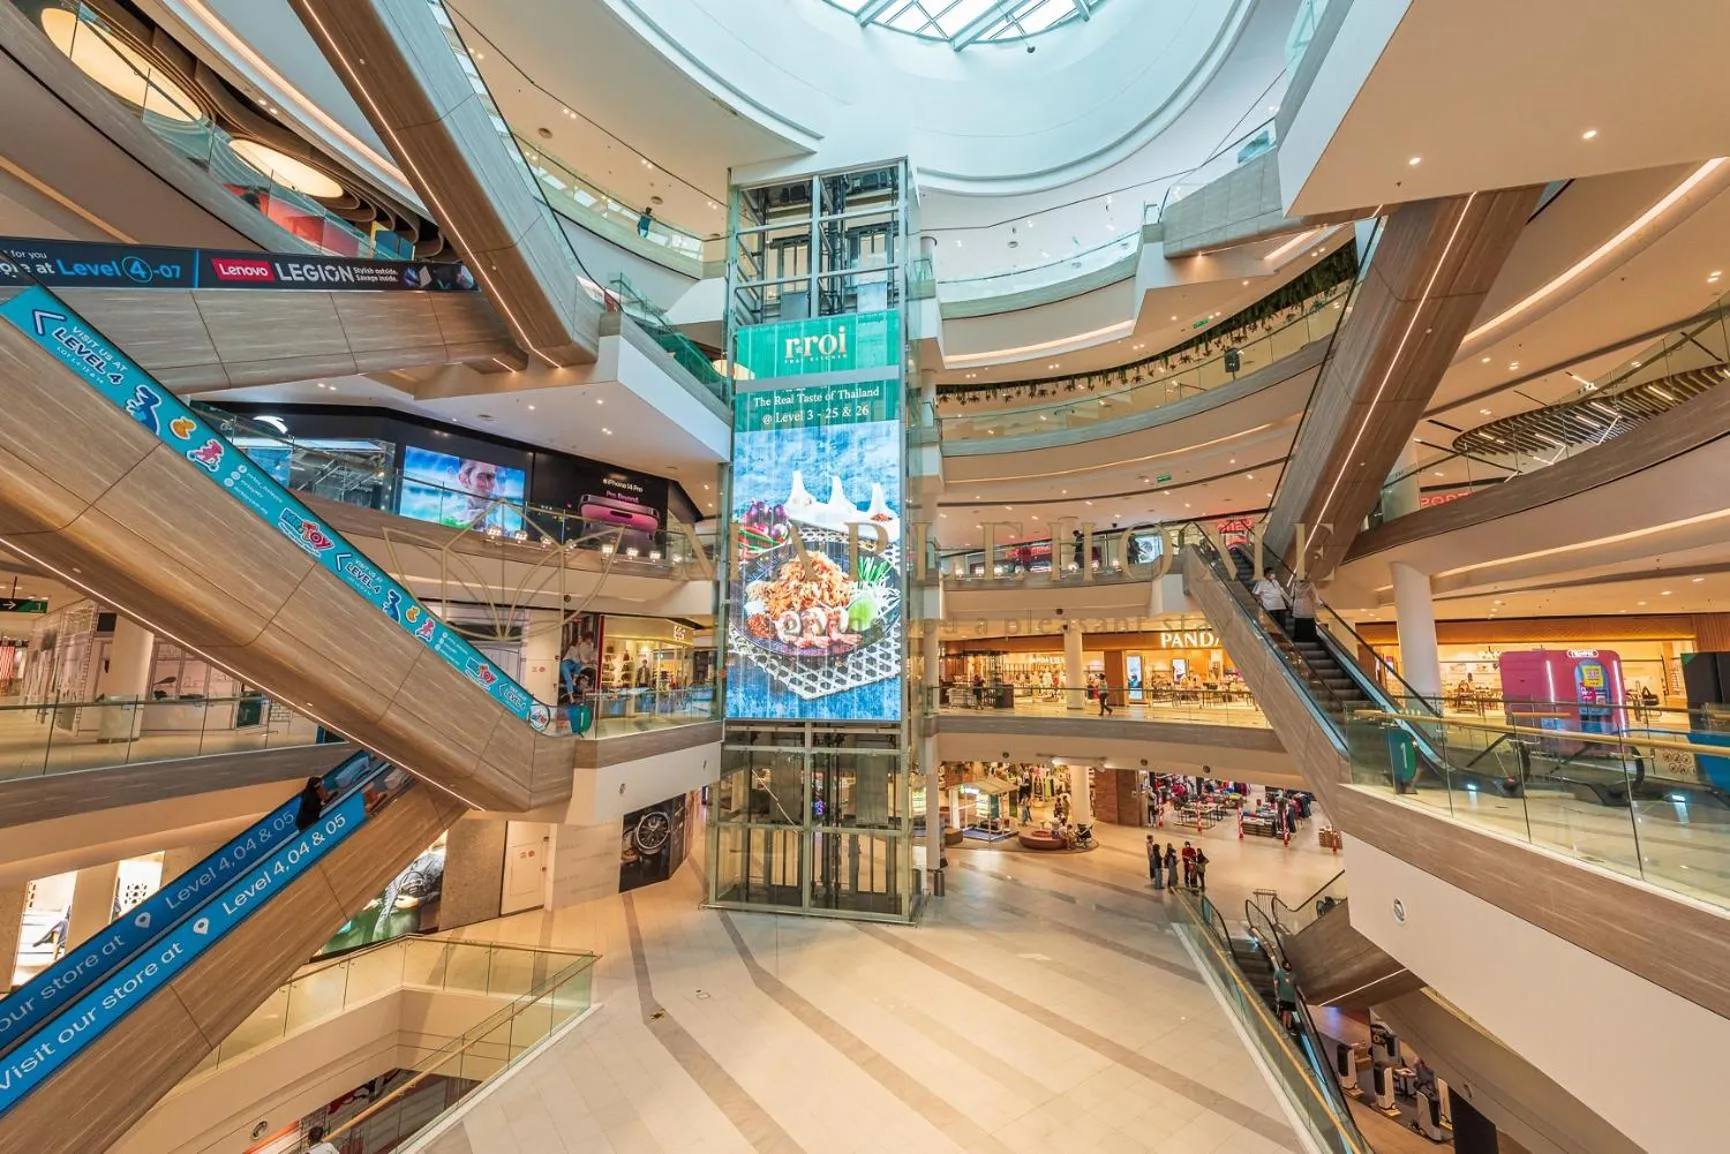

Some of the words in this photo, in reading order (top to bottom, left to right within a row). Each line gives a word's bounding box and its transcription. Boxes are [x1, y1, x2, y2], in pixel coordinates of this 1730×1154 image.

[28, 252, 47, 260] you
[35, 262, 56, 274] at
[56, 259, 120, 277] Level
[219, 263, 269, 277] Lenovo
[275, 263, 355, 283] LEGION
[52, 327, 107, 374] LEVEL
[107, 372, 124, 385] 4
[72, 326, 99, 348] VISIT
[99, 348, 113, 361] US
[113, 361, 128, 372] AT
[753, 396, 771, 408] The
[774, 394, 794, 405] Real
[798, 391, 822, 403] Taste
[825, 390, 837, 401] of
[837, 386, 880, 399] Thailand
[762, 414, 772, 425] @
[775, 410, 803, 423] Level
[806, 408, 814, 420] 3
[825, 407, 838, 418] 25
[842, 406, 851, 417] &
[856, 405, 869, 416] 26
[345, 562, 373, 589] LEVEL
[373, 585, 382, 594] 4
[0, 999, 36, 1034] our
[40, 953, 100, 1003] store
[102, 933, 127, 956] at
[165, 867, 217, 910] Level
[258, 828, 273, 843] &
[273, 811, 295, 831] 05
[0, 1041, 55, 1093] Visit
[57, 1009, 98, 1046] our
[101, 960, 159, 1011] store
[161, 940, 183, 963] at
[222, 873, 273, 916] Level
[311, 830, 326, 847] &
[325, 813, 347, 834] 05
